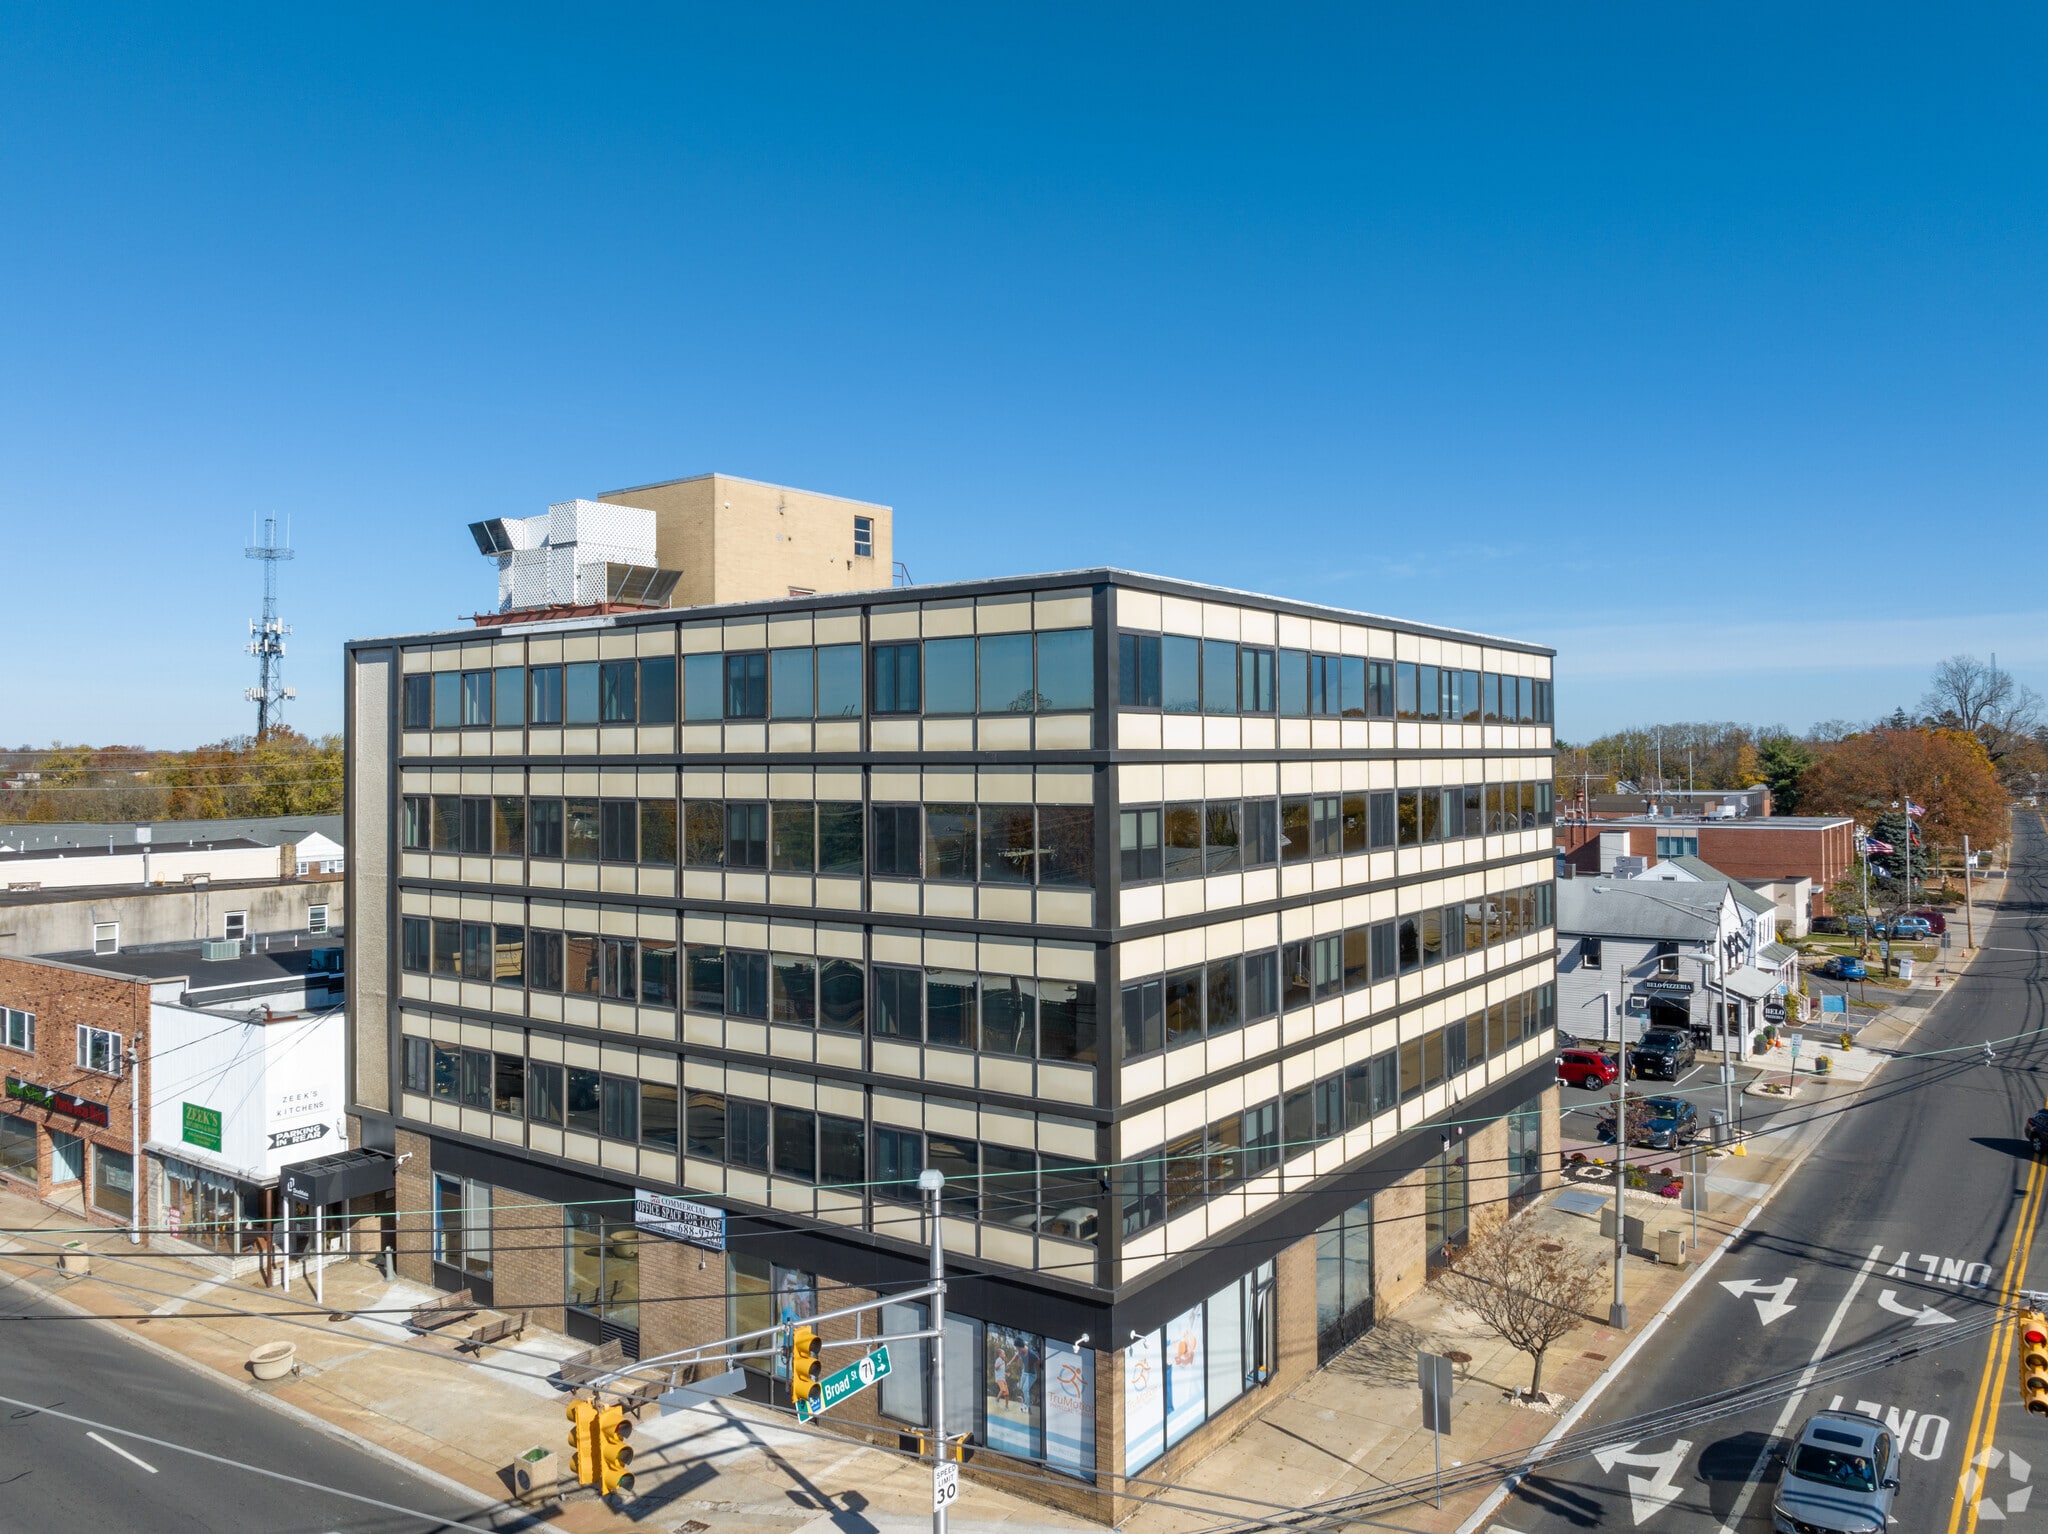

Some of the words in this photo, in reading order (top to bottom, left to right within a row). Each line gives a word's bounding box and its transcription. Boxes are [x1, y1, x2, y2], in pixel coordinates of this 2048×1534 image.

[1646, 981, 1662, 989] BELO
[1662, 982, 1692, 991] PIZZERIA
[1765, 1007, 1785, 1016] BELO
[282, 1090, 318, 1103] ZEEK'S
[186, 1106, 218, 1127] ZEEK'S
[276, 1101, 324, 1116] KITCHENS
[275, 1124, 321, 1141] PARKING
[275, 1138, 288, 1147] IN
[292, 1131, 321, 1143] REAR
[661, 1198, 708, 1216] COMMERCIAL
[636, 1200, 660, 1216] OFFICE
[661, 1206, 682, 1221] SPACE
[684, 1212, 698, 1226] FOR
[700, 1216, 722, 1232] LEASE
[1887, 1251, 1993, 1290] ONLY
[824, 1374, 850, 1401] Broad
[850, 1369, 857, 1381] St
[861, 1361, 873, 1379] 71
[877, 1353, 882, 1363] S
[936, 1464, 957, 1480] SPEED
[938, 1474, 954, 1488] LIMIT
[936, 1483, 956, 1504] 30
